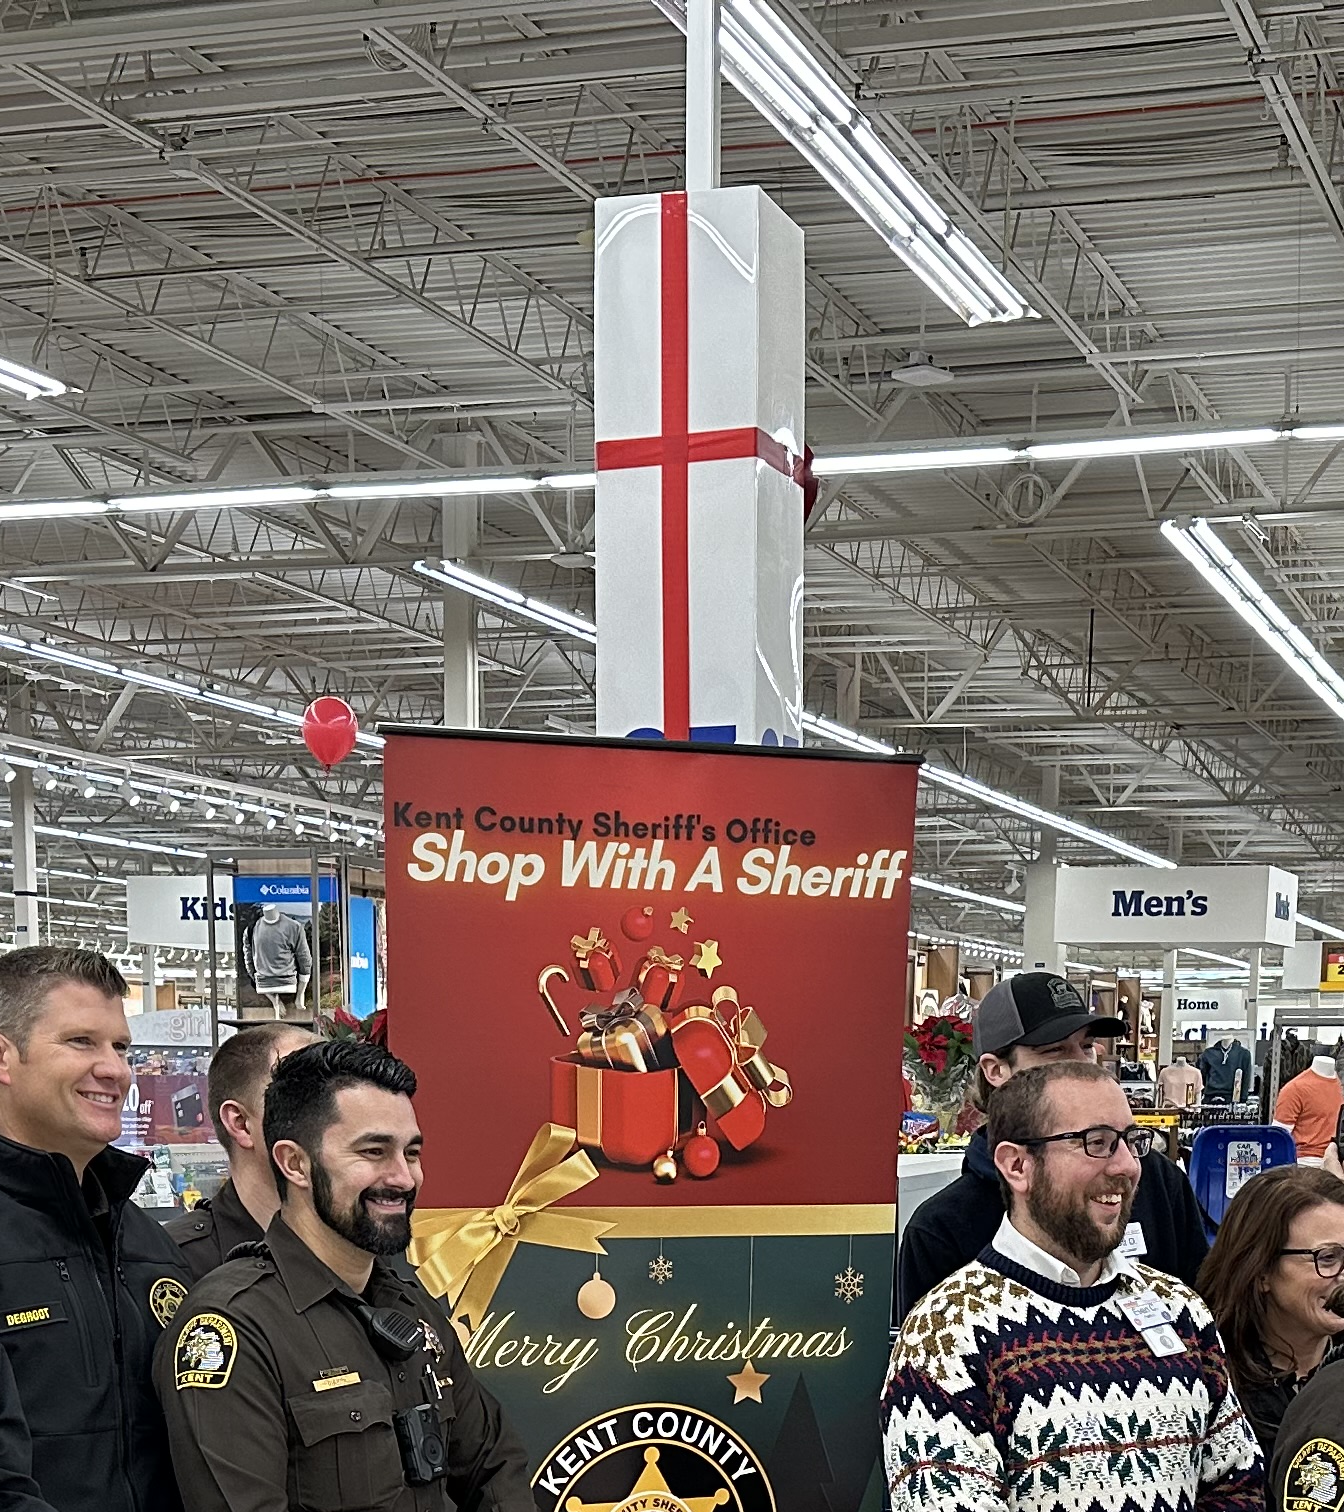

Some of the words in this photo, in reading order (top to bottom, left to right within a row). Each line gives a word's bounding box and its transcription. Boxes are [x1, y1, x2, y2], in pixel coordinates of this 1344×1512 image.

[393, 802, 465, 830] Kent
[474, 806, 584, 840] County
[592, 810, 716, 842] Sheriff's
[725, 817, 816, 846] Office
[407, 829, 546, 902] Shop
[561, 838, 676, 891] With
[683, 846, 724, 893] A
[736, 844, 908, 899] Sheriff
[269, 884, 310, 896] Columbia
[1111, 889, 1208, 917] Men's
[1176, 998, 1219, 1010] Home
[462, 1309, 600, 1395] Merry
[625, 1303, 854, 1373] Christmas
[180, 1373, 214, 1384] KENT
[538, 1418, 619, 1497] KENT
[632, 1411, 757, 1482] COUNTY
